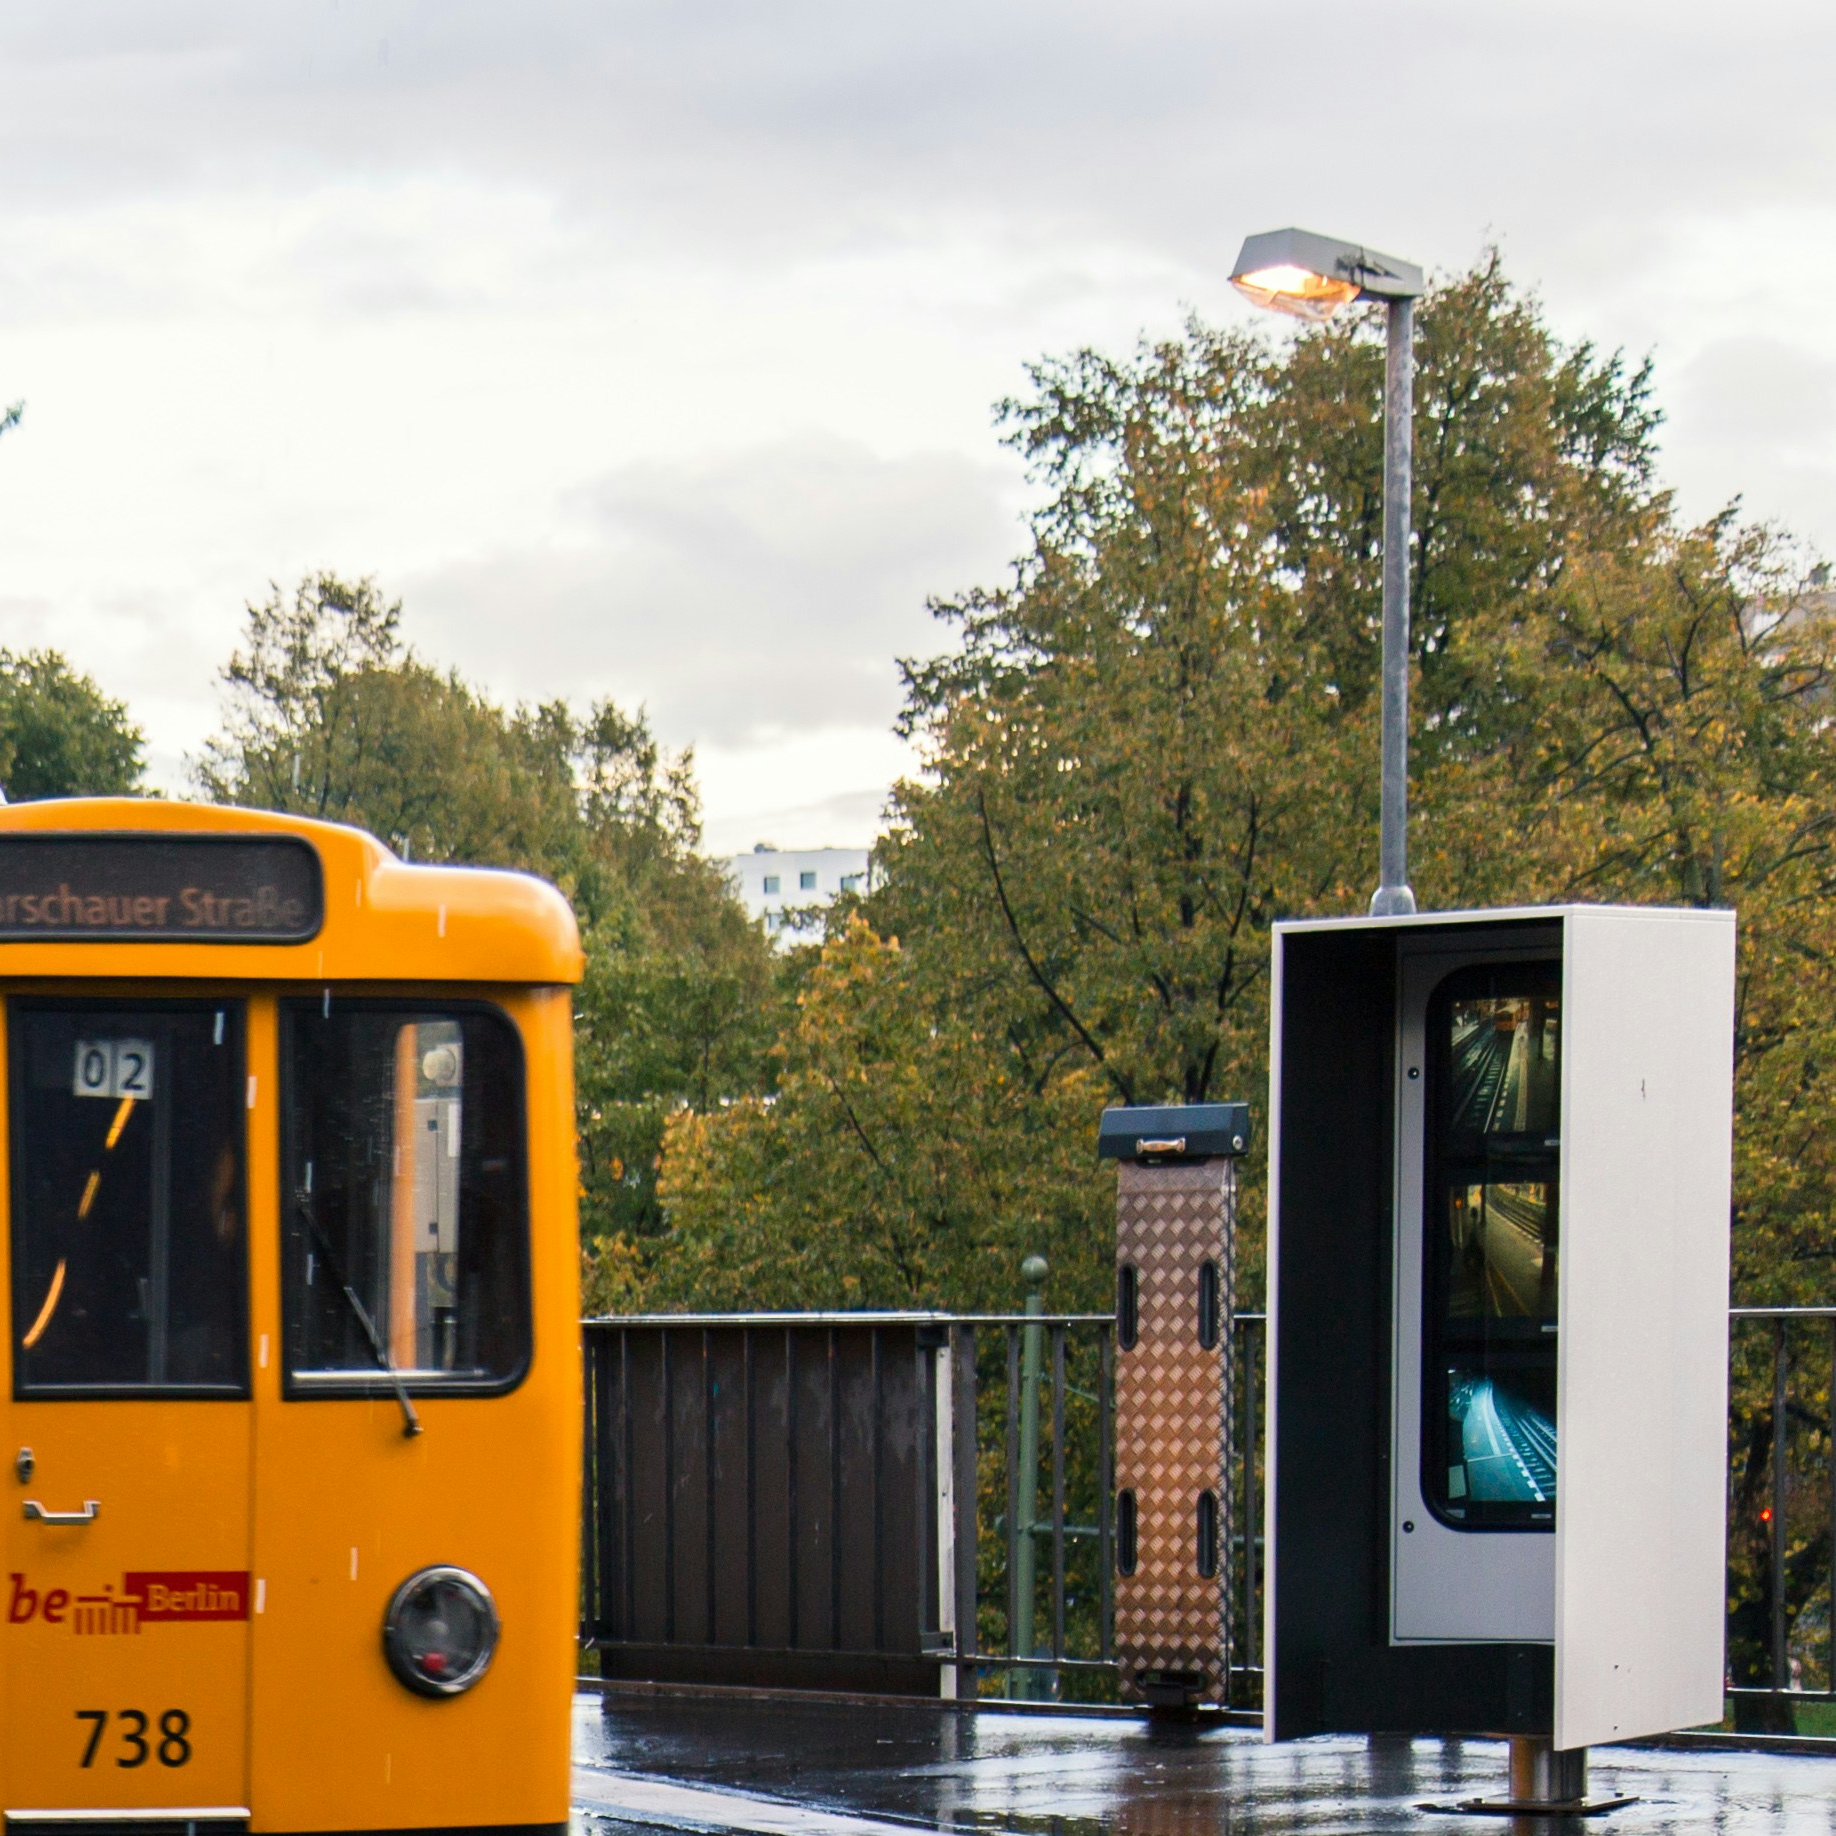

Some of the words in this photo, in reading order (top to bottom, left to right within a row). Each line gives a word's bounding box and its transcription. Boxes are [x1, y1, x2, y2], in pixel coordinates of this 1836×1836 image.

[180, 886, 306, 928] Straße
[84, 1049, 145, 1091] 02
[145, 1582, 240, 1612] Berlin
[74, 1709, 193, 1768] 738
